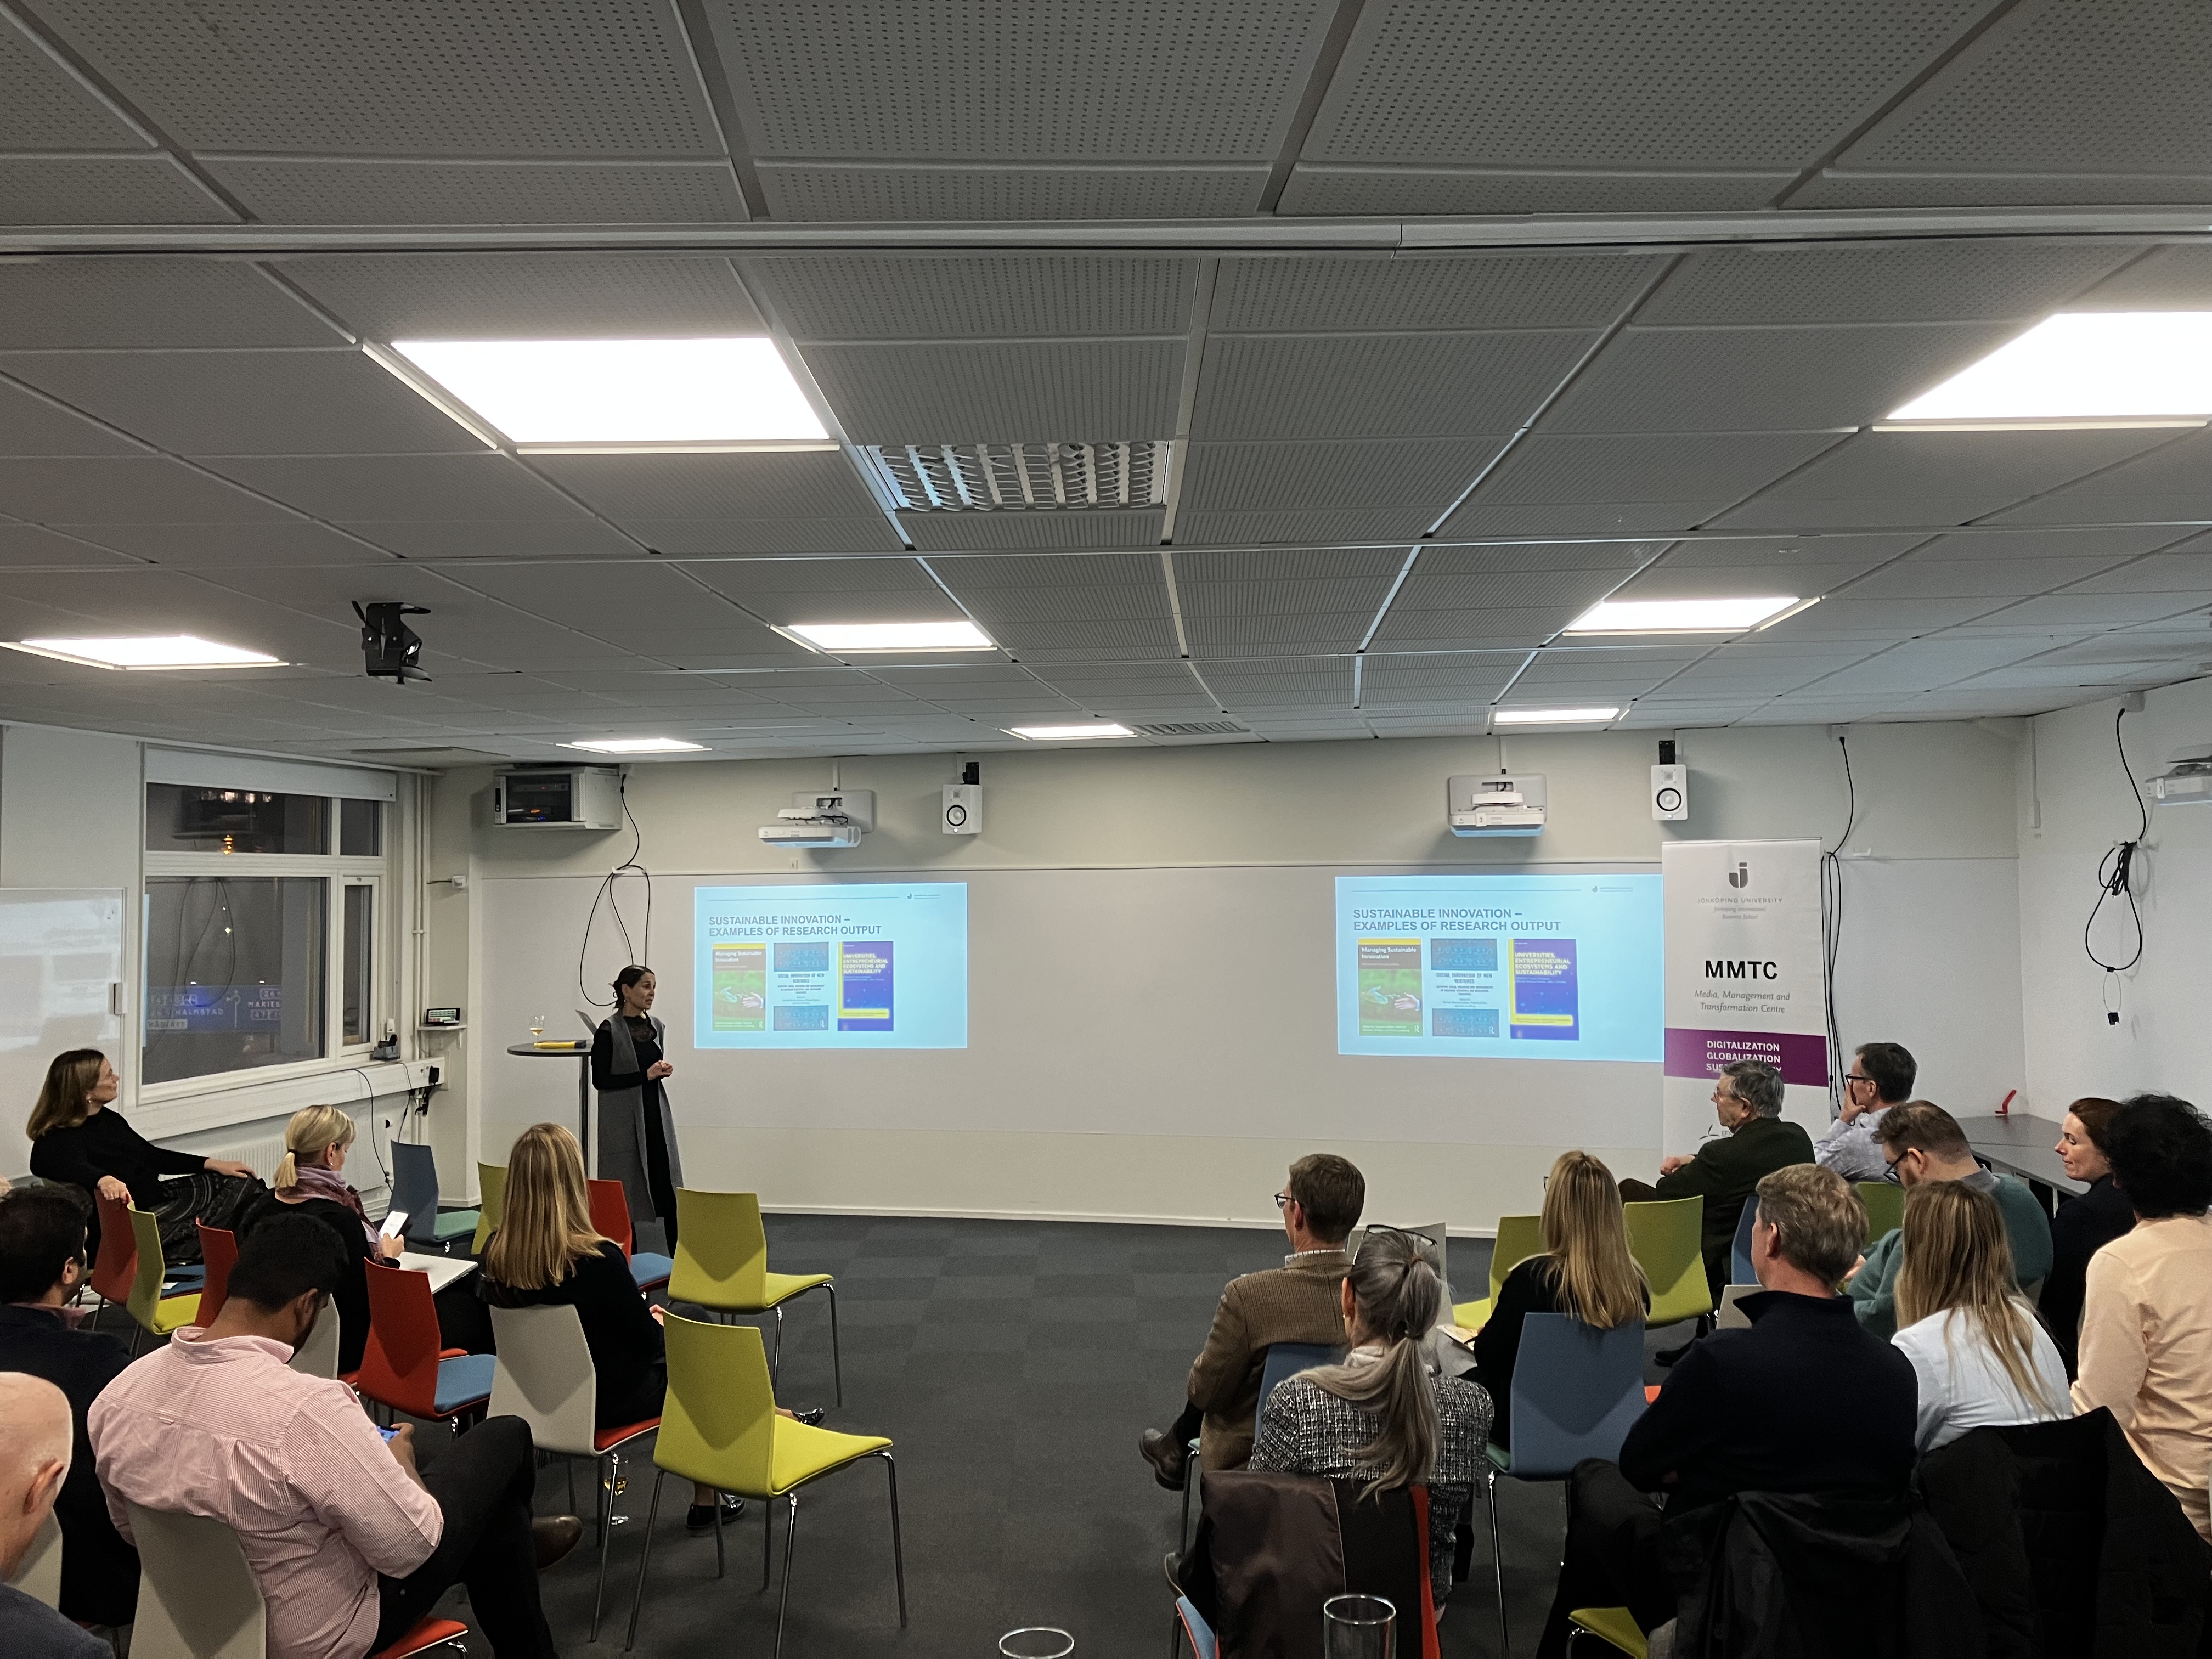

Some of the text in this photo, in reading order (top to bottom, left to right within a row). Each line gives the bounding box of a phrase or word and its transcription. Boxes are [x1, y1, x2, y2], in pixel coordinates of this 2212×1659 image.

[1353, 909, 1435, 918] SUSTAINABLE
[1439, 909, 1511, 918] INNOVATION
[709, 916, 778, 926] SUSTAINABLE
[781, 915, 842, 924] INNOVATION
[1353, 921, 1561, 931] EXAMPLES OF RESEARCH OUTPUT
[709, 925, 882, 936] EXAMPLES OF RESEARCH OUTPUT
[1705, 960, 1778, 980] MMTC
[1695, 990, 1720, 999] Media,
[1723, 990, 1774, 1002] Management
[1700, 1002, 1785, 1013] Transformation Centre
[1707, 1041, 1780, 1052] DIGITALIZATION
[1707, 1052, 1781, 1063] GLOBALIZATION
